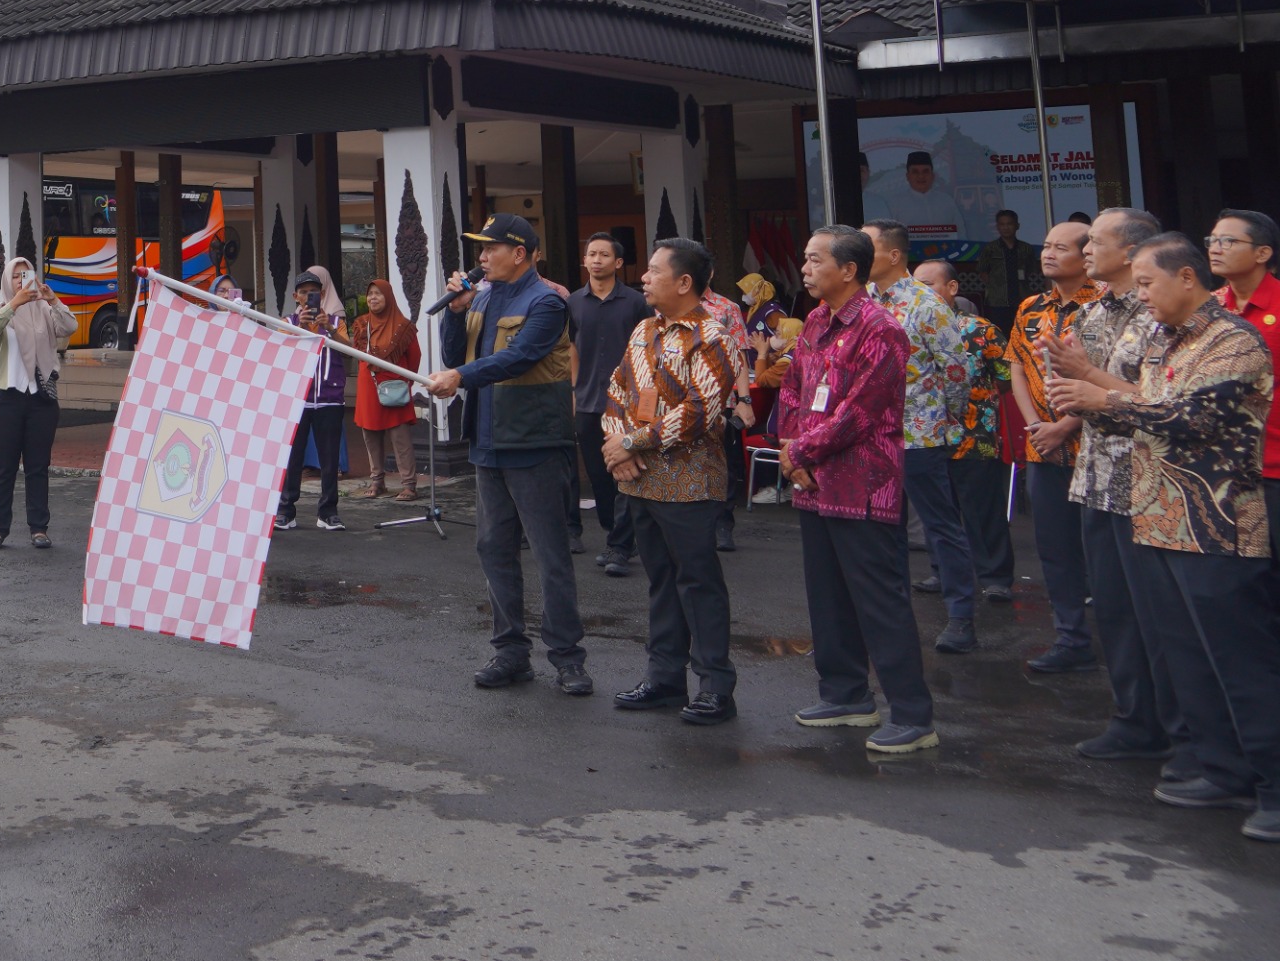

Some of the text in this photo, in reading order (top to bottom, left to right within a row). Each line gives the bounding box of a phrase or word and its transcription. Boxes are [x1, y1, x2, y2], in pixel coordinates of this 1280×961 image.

[989, 152, 1060, 165] SELAMT
[995, 164, 1043, 173] SAUDAR
[996, 172, 1096, 185] Kabupatn Wono
